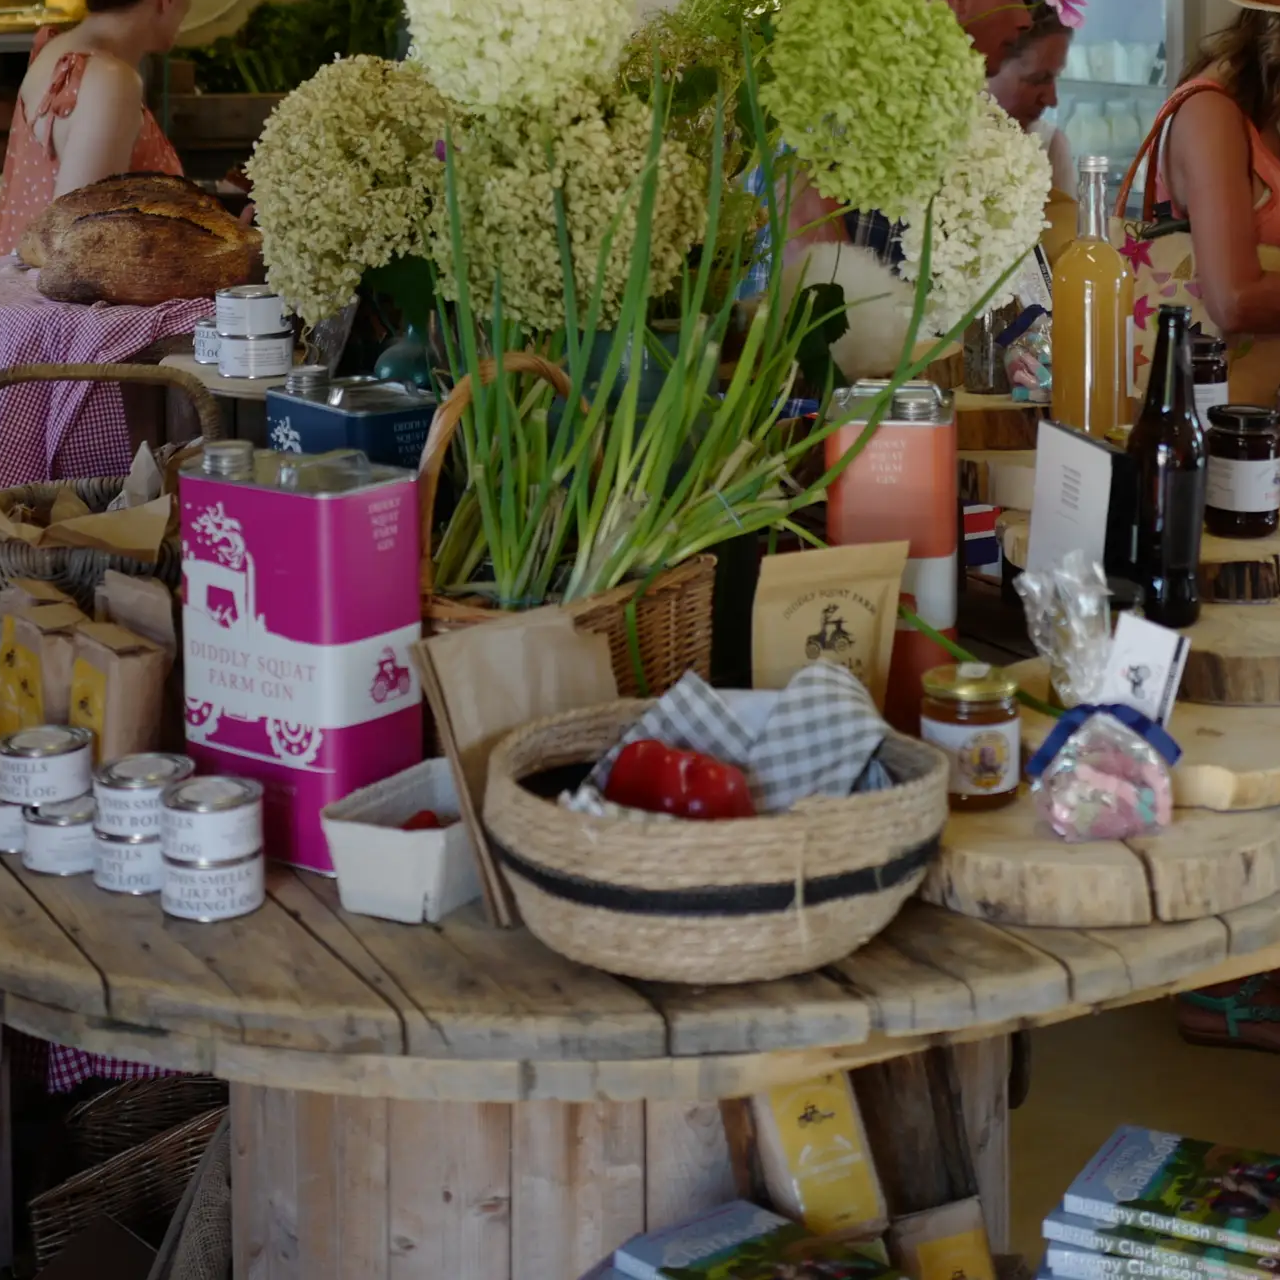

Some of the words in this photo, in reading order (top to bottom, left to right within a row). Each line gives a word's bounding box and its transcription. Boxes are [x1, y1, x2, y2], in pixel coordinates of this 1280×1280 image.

[393, 419, 429, 433] DIDDLY
[871, 462, 902, 474] FARM
[875, 475, 897, 485] GIN
[367, 498, 401, 515] DIDDLY
[370, 509, 401, 527] SQUAT
[372, 524, 399, 540] FARM
[376, 537, 395, 552] GIN
[783, 592, 815, 620] DIDDLY
[819, 588, 850, 600] SQUAT
[851, 592, 877, 616] FARM
[189, 639, 250, 669] DIDDLY
[257, 655, 316, 682] SQUAT
[207, 668, 255, 694] FARM
[261, 680, 294, 701] GIN
[24, 785, 58, 799] LOG
[119, 872, 151, 886] LOG
[168, 870, 196, 885] THIS
[180, 886, 210, 900] LIKE
[1113, 1133, 1182, 1202] Clarkson
[1079, 1200, 1137, 1225] Jeremy
[1138, 1211, 1211, 1240] Clarkson
[662, 1215, 789, 1268] Clarkson
[1117, 1240, 1190, 1270] Clarkson
[1063, 1253, 1121, 1275] Jeremy
[1126, 1258, 1202, 1280] Clarkson
